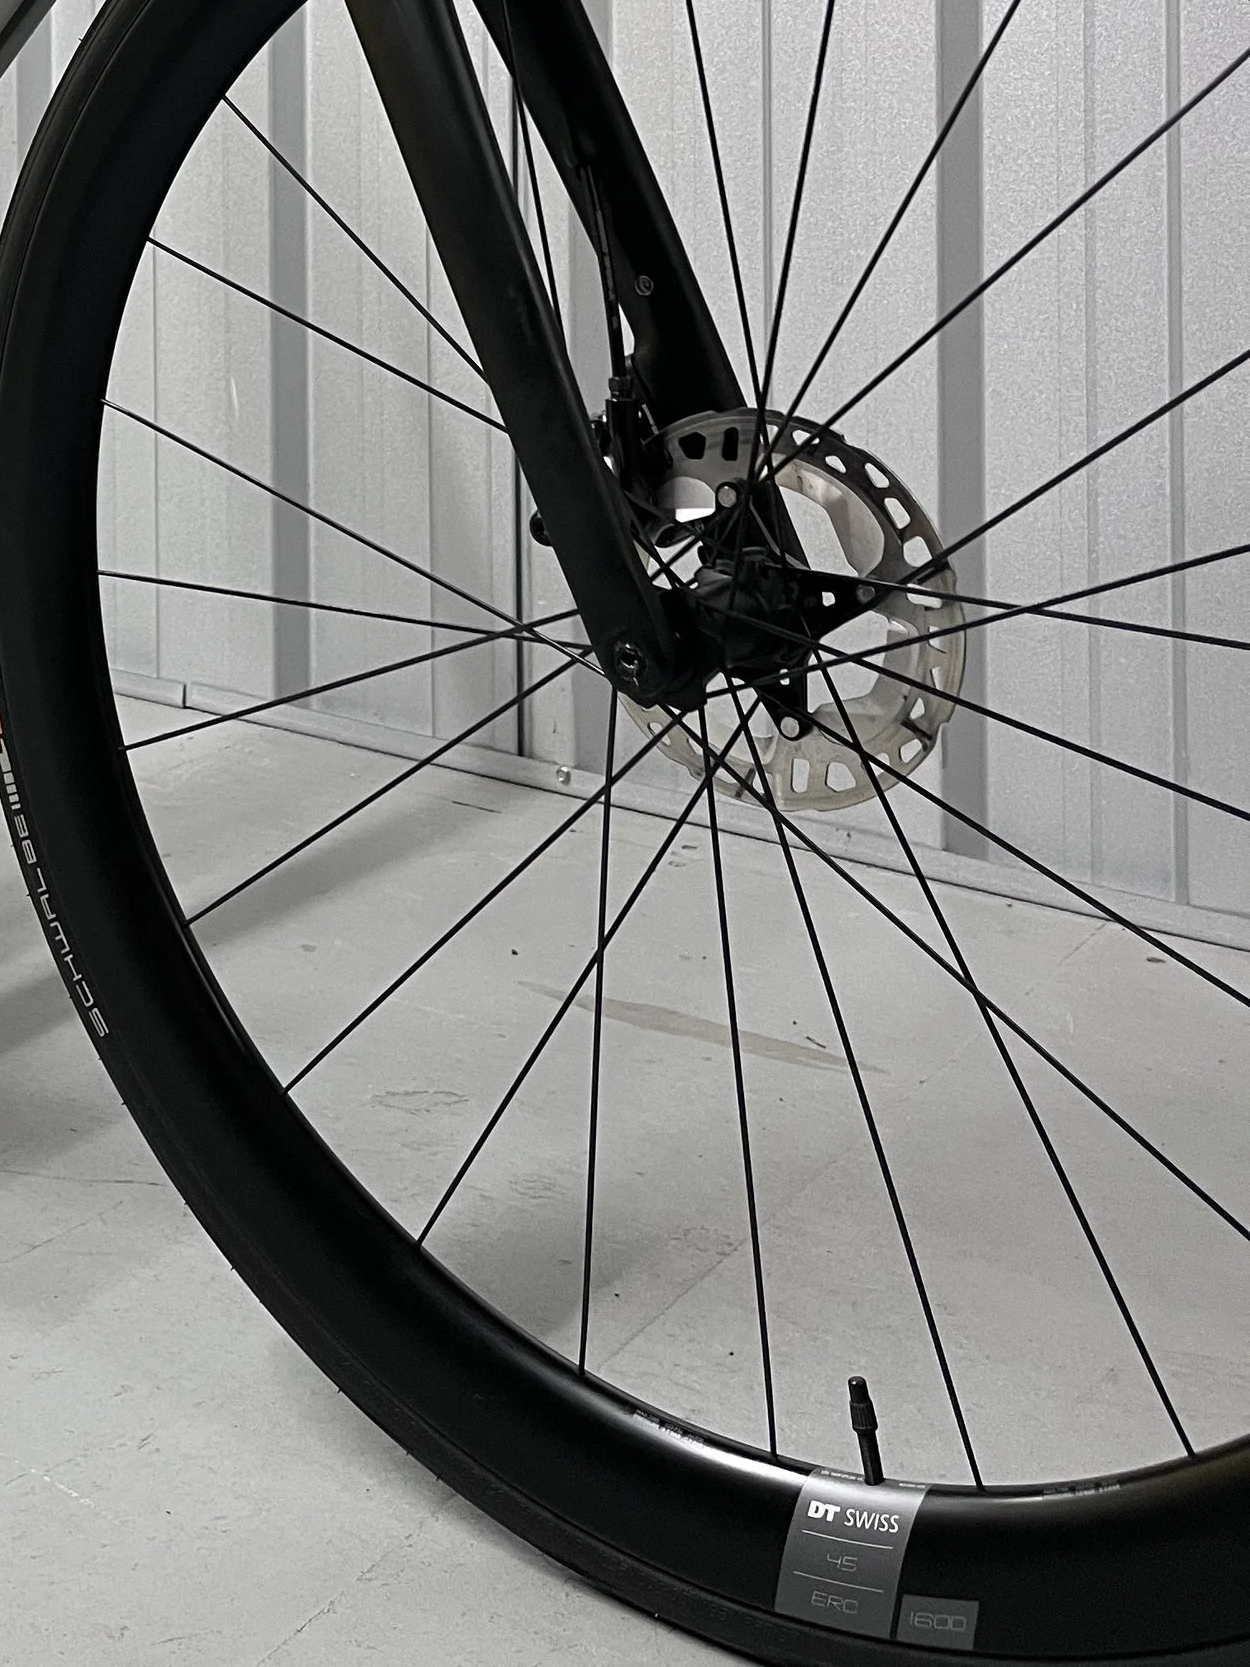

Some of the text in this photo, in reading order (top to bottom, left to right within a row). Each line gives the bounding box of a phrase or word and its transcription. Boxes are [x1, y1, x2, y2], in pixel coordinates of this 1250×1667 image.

[14, 813, 110, 1038] SCHWALBE
[807, 1499, 900, 1533] DT SWISS
[826, 1552, 859, 1573] 45
[810, 1590, 859, 1615] ERC
[909, 1611, 967, 1632] 1600
